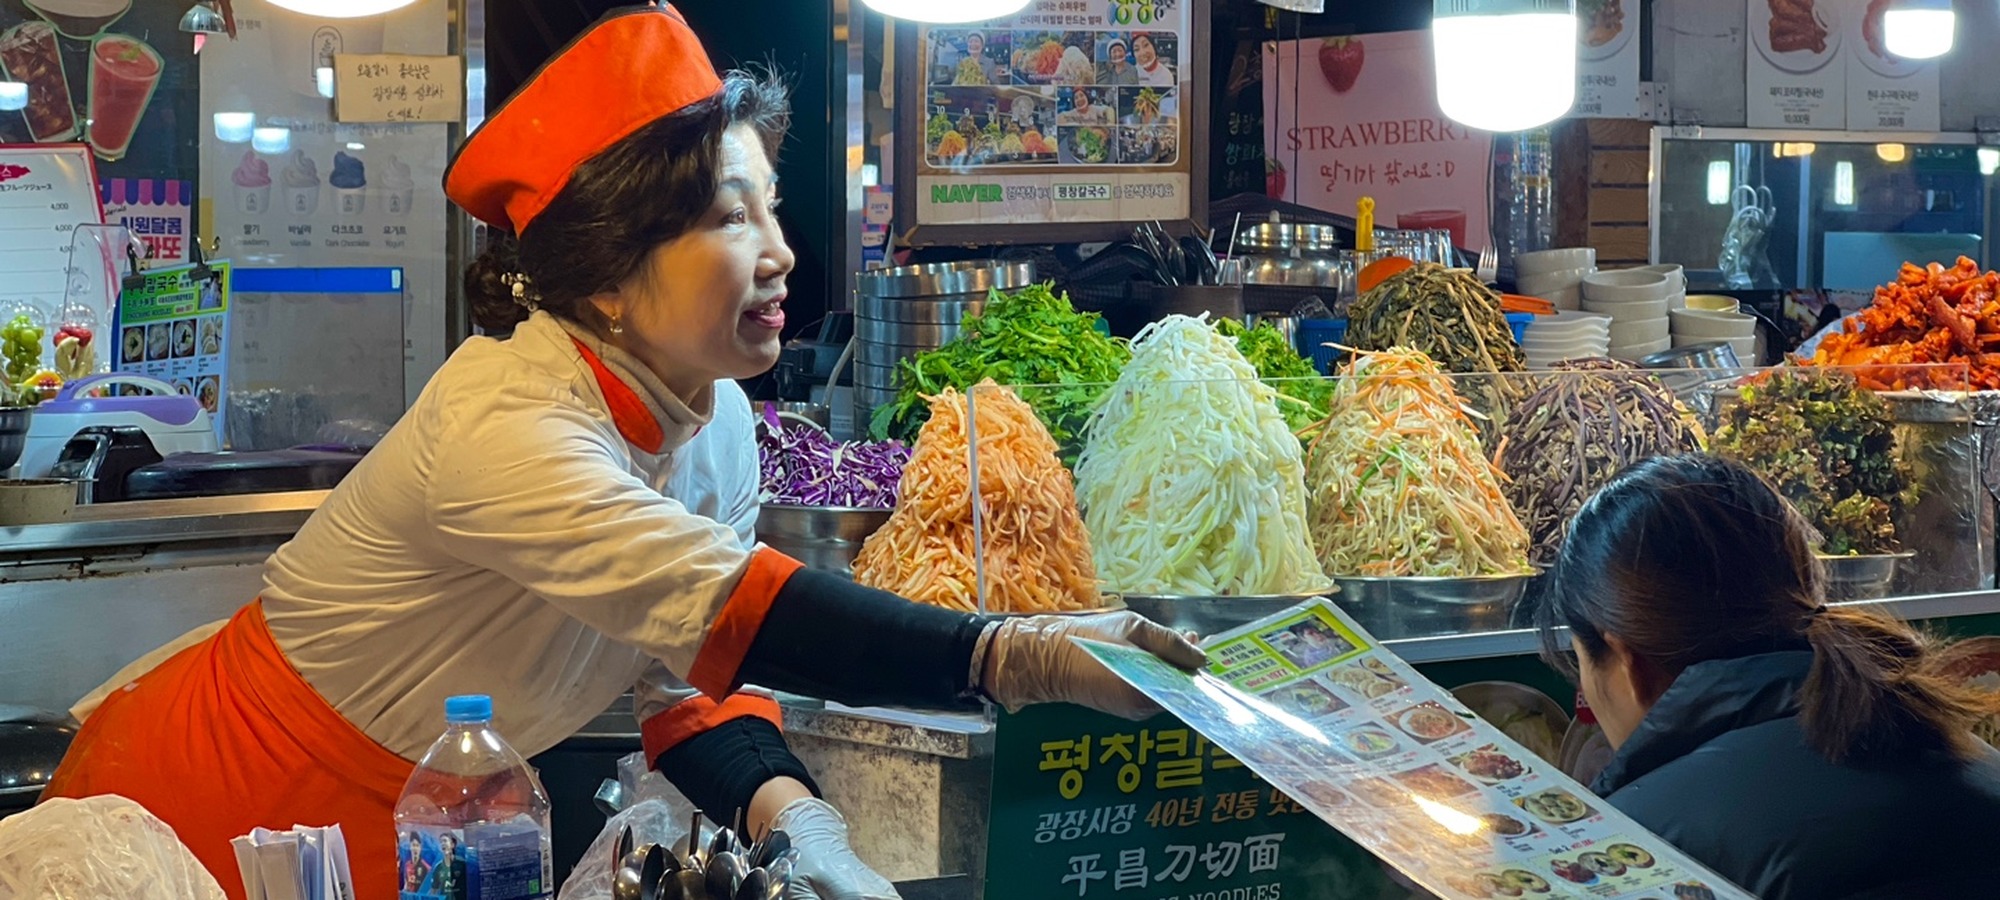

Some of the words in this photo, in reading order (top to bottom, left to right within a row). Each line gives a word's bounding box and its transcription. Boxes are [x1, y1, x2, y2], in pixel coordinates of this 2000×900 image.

[1065, 16, 1086, 25] 만드는
[1320, 160, 1376, 192] 딸기가
[931, 184, 1004, 204] NAVER
[1057, 185, 1108, 199] 평창칼국수
[1124, 184, 1174, 199] 검색하세요
[288, 225, 312, 235] 바닐라
[1034, 803, 1138, 844] 광장시장
[1144, 796, 1205, 829] 40년
[1211, 789, 1260, 823] 전통
[1060, 832, 1287, 898] 平昌刀切面
